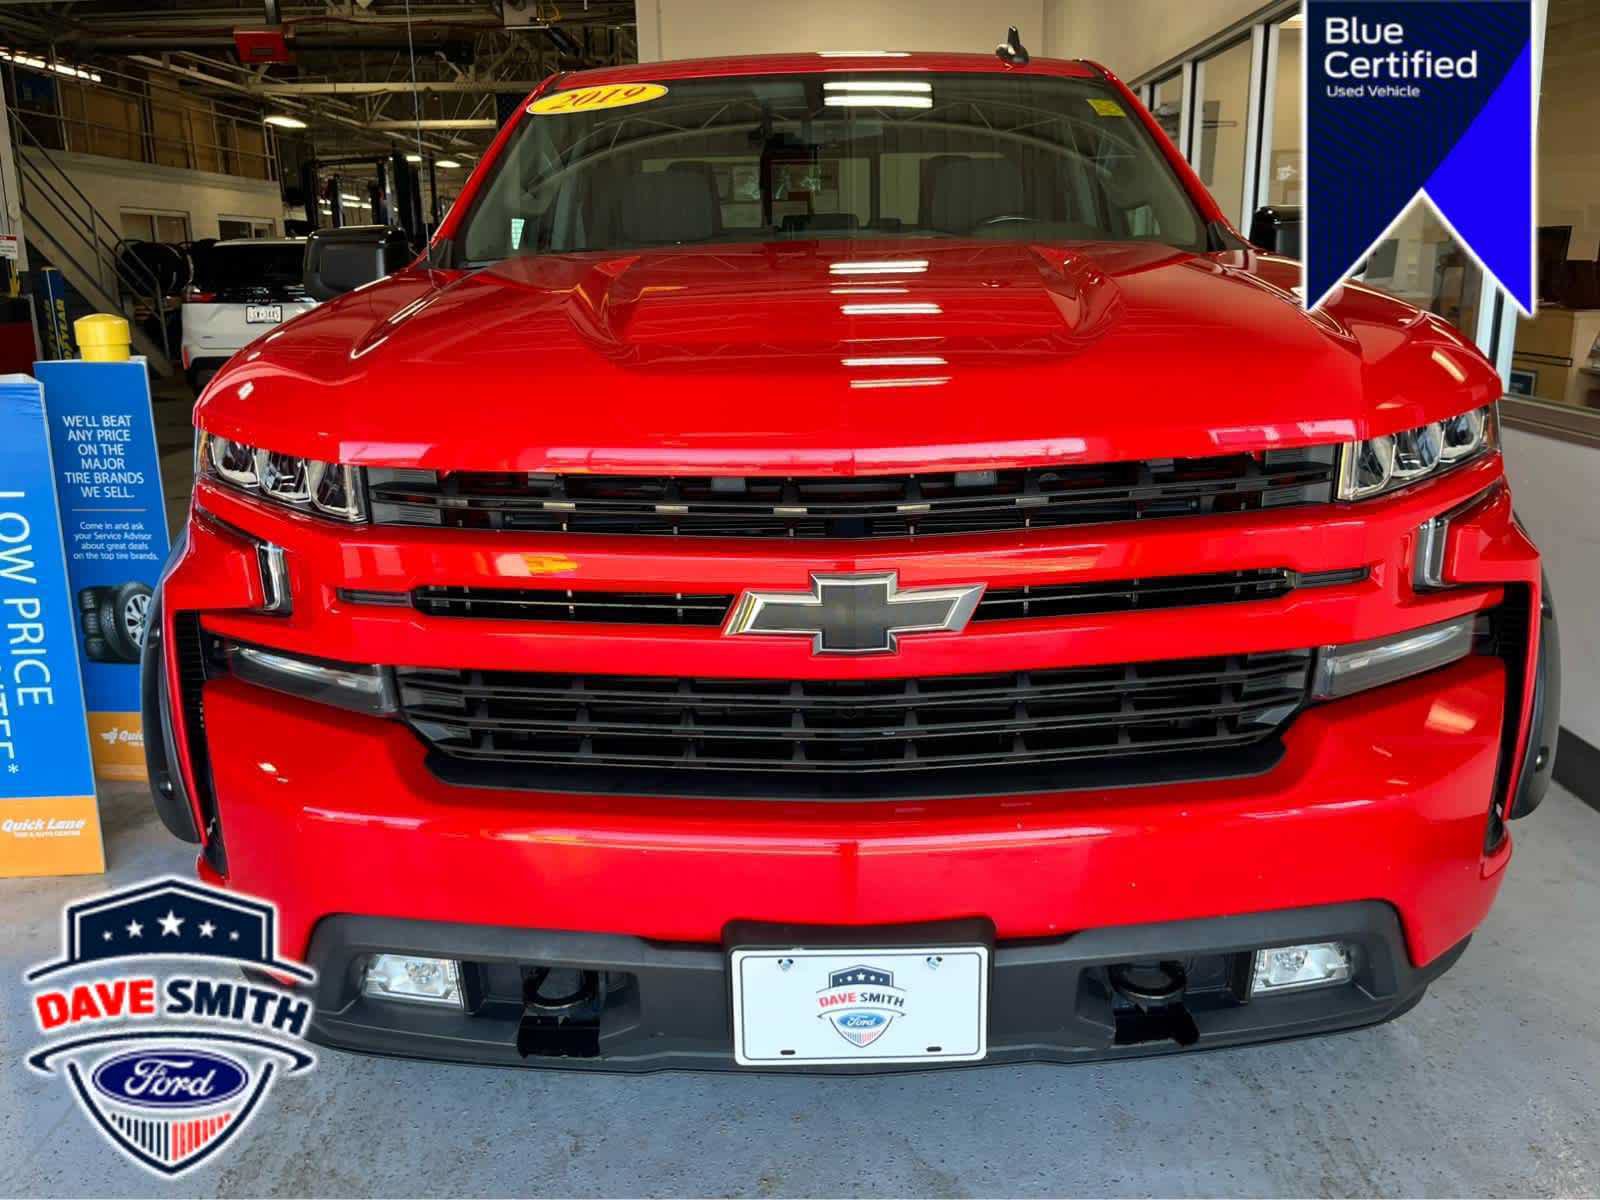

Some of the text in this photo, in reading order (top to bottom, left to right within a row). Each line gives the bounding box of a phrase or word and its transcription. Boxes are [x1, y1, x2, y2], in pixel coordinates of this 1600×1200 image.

[62, 415, 132, 428] WE'LL BEAT
[68, 429, 132, 441] ANY PRICE
[78, 443, 125, 456] ON THE
[81, 457, 126, 470] MAJOR
[64, 472, 145, 485] TIRE BRANDS
[80, 486, 135, 498] WE SELL.
[80, 521, 144, 530] Come in and ask
[73, 532, 153, 541] your Service Advisor
[81, 542, 149, 552] about great deals
[73, 552, 84, 560] on
[86, 552, 99, 560] the
[101, 552, 114, 561] top
[5, 597, 54, 706] PRICE
[119, 729, 144, 743] Quic
[2, 818, 86, 832] Quick Lane
[819, 991, 905, 1008] DAVE SMITH
[847, 1015, 877, 1026] Ford
